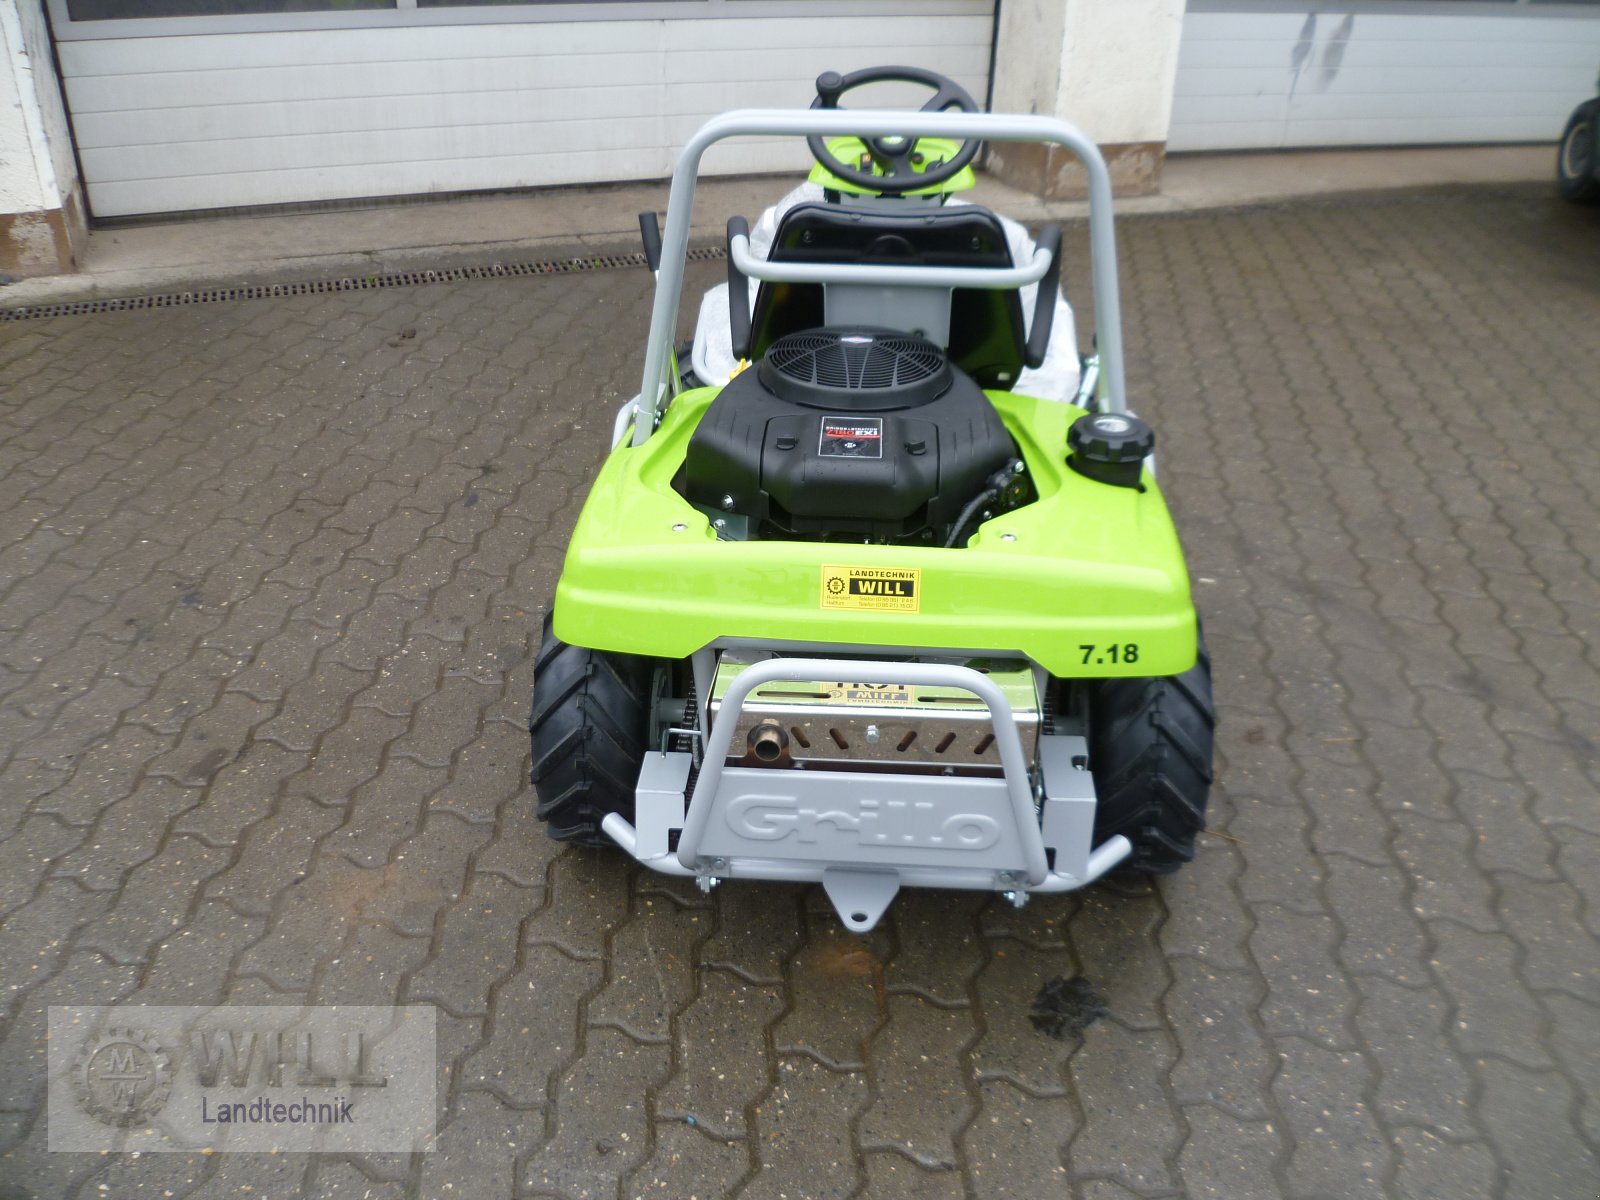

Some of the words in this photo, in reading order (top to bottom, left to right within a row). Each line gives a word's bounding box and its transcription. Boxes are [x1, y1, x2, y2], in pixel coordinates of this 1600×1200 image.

[849, 570, 915, 579] LANDTECHNIK
[858, 580, 905, 595] WILL
[1078, 643, 1139, 665] 7.18
[726, 795, 1000, 850] Grillo
